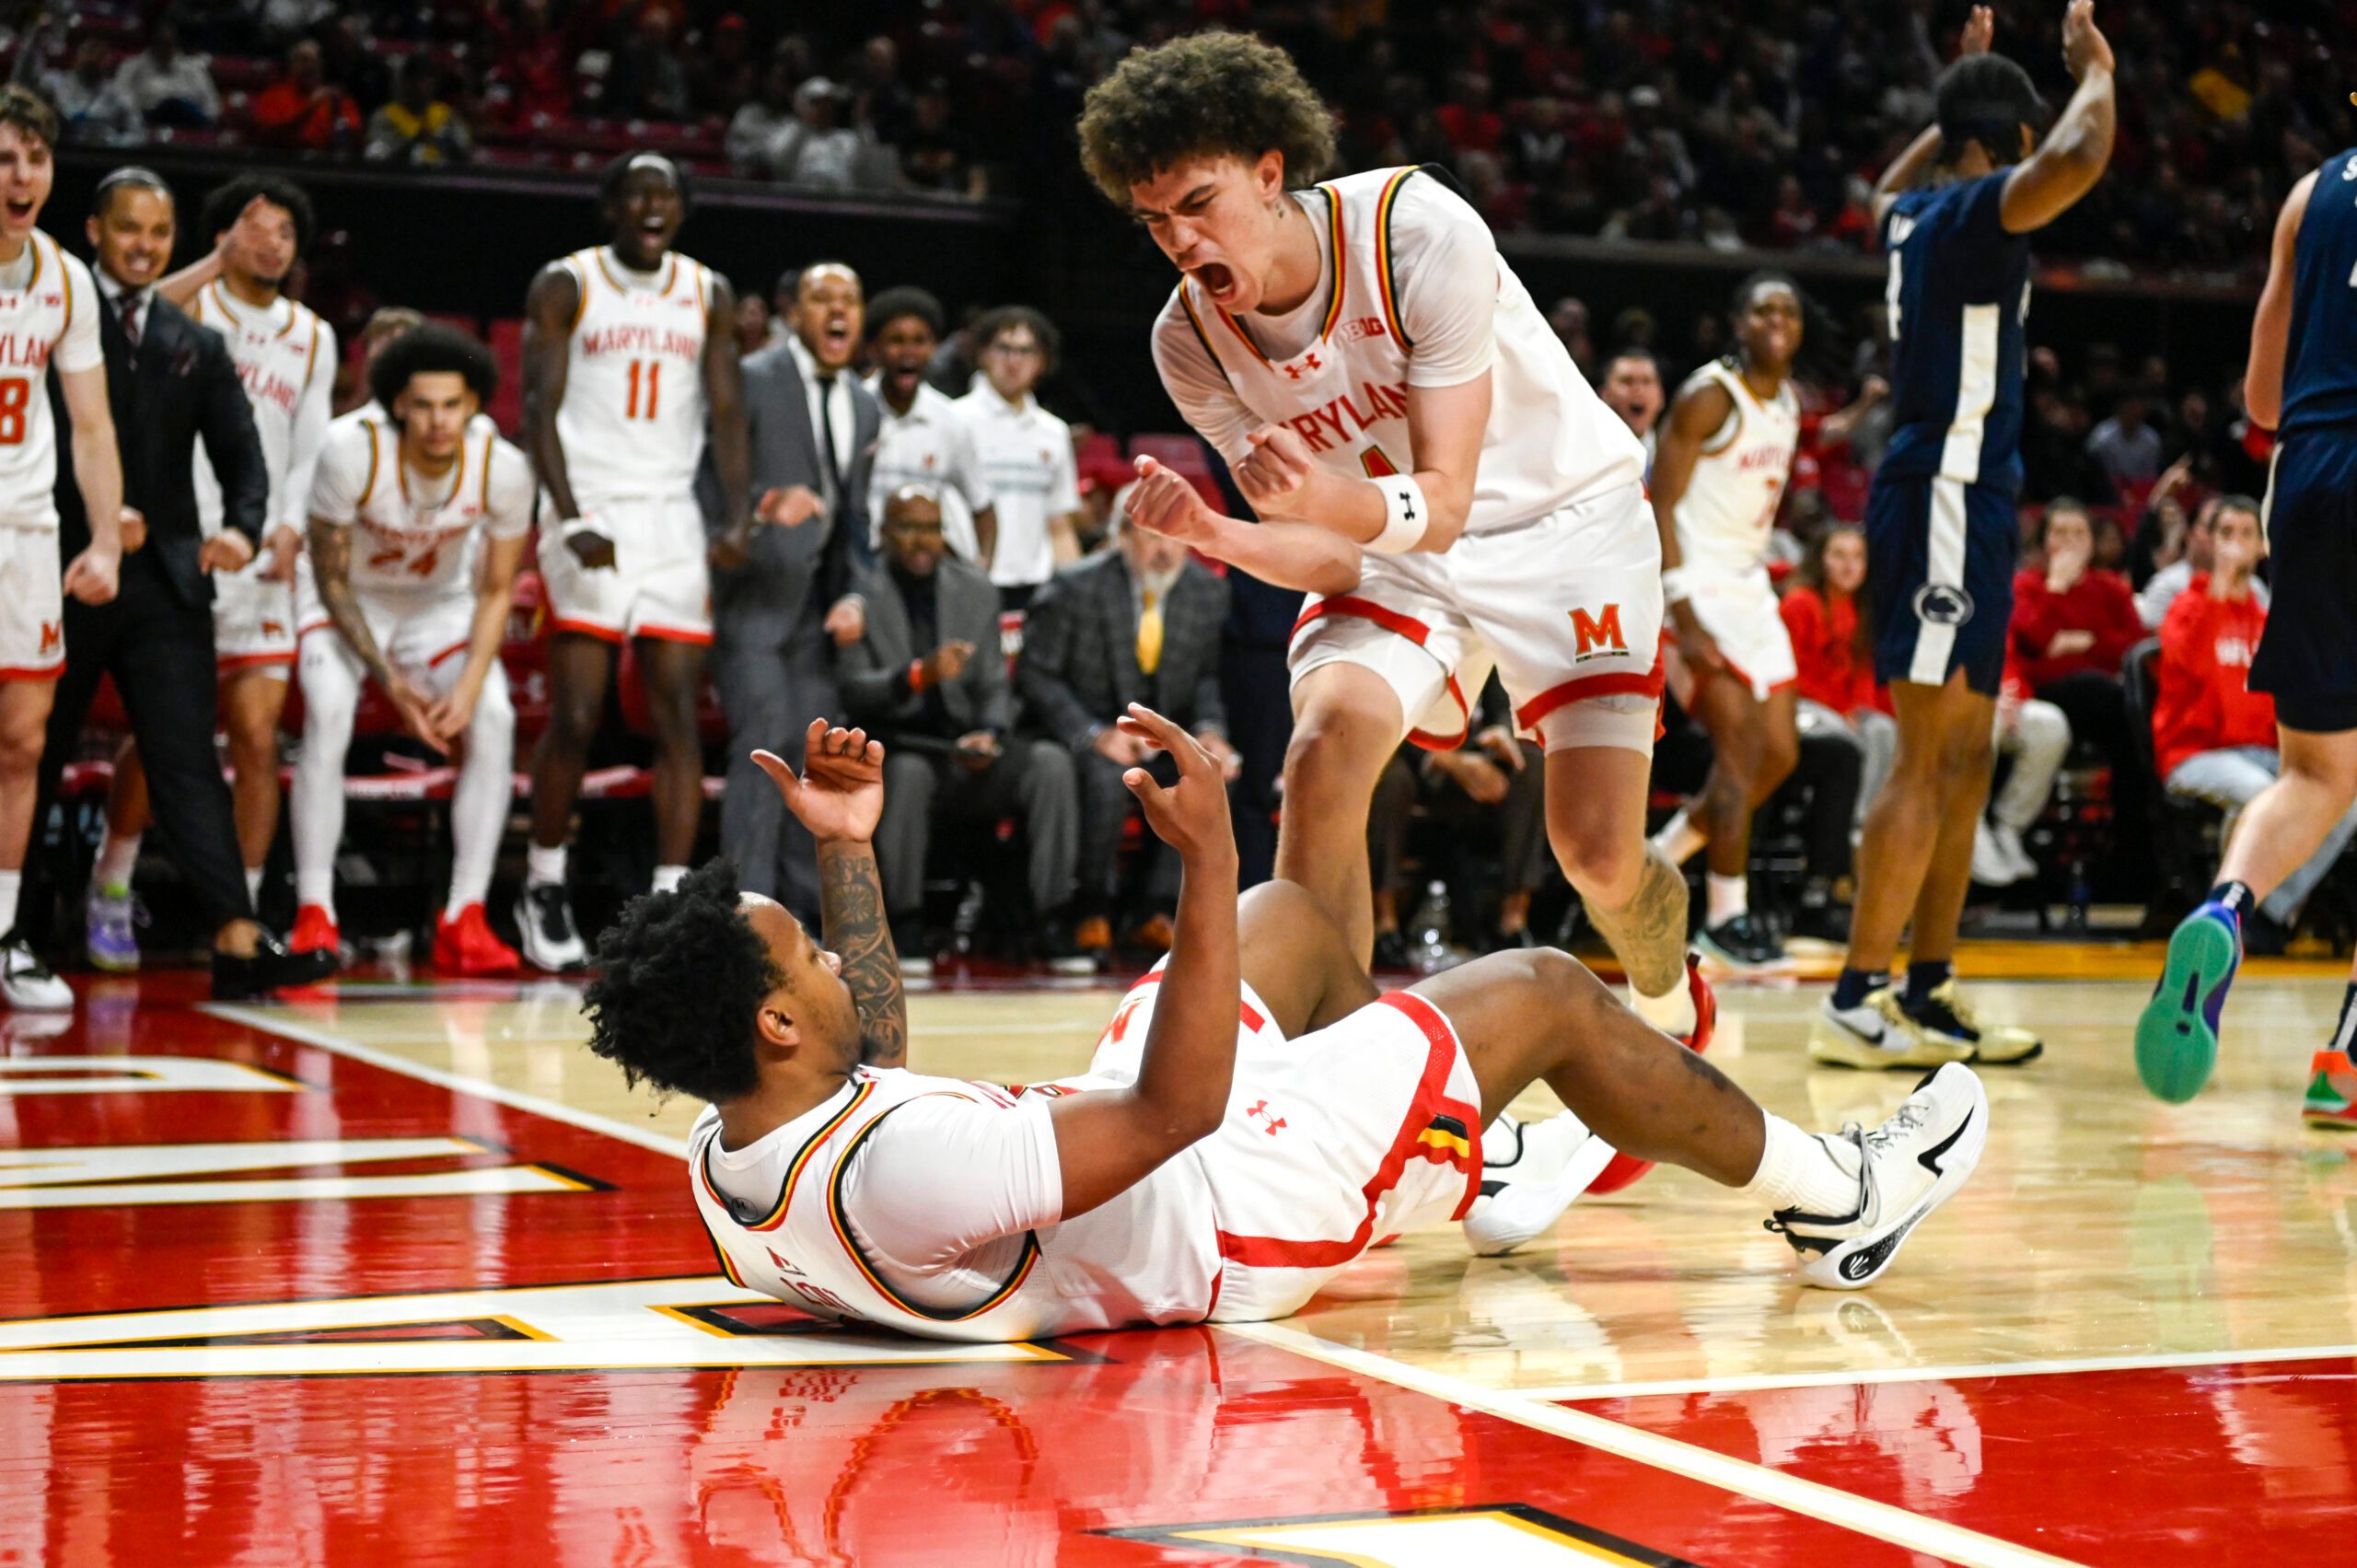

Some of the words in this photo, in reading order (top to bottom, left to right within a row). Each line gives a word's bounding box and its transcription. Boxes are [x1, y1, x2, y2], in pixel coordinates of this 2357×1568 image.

[582, 326, 697, 360] MARYLAND
[626, 358, 660, 421] 11
[1279, 380, 1408, 453] RYLAN
[1568, 603, 1628, 656] M
